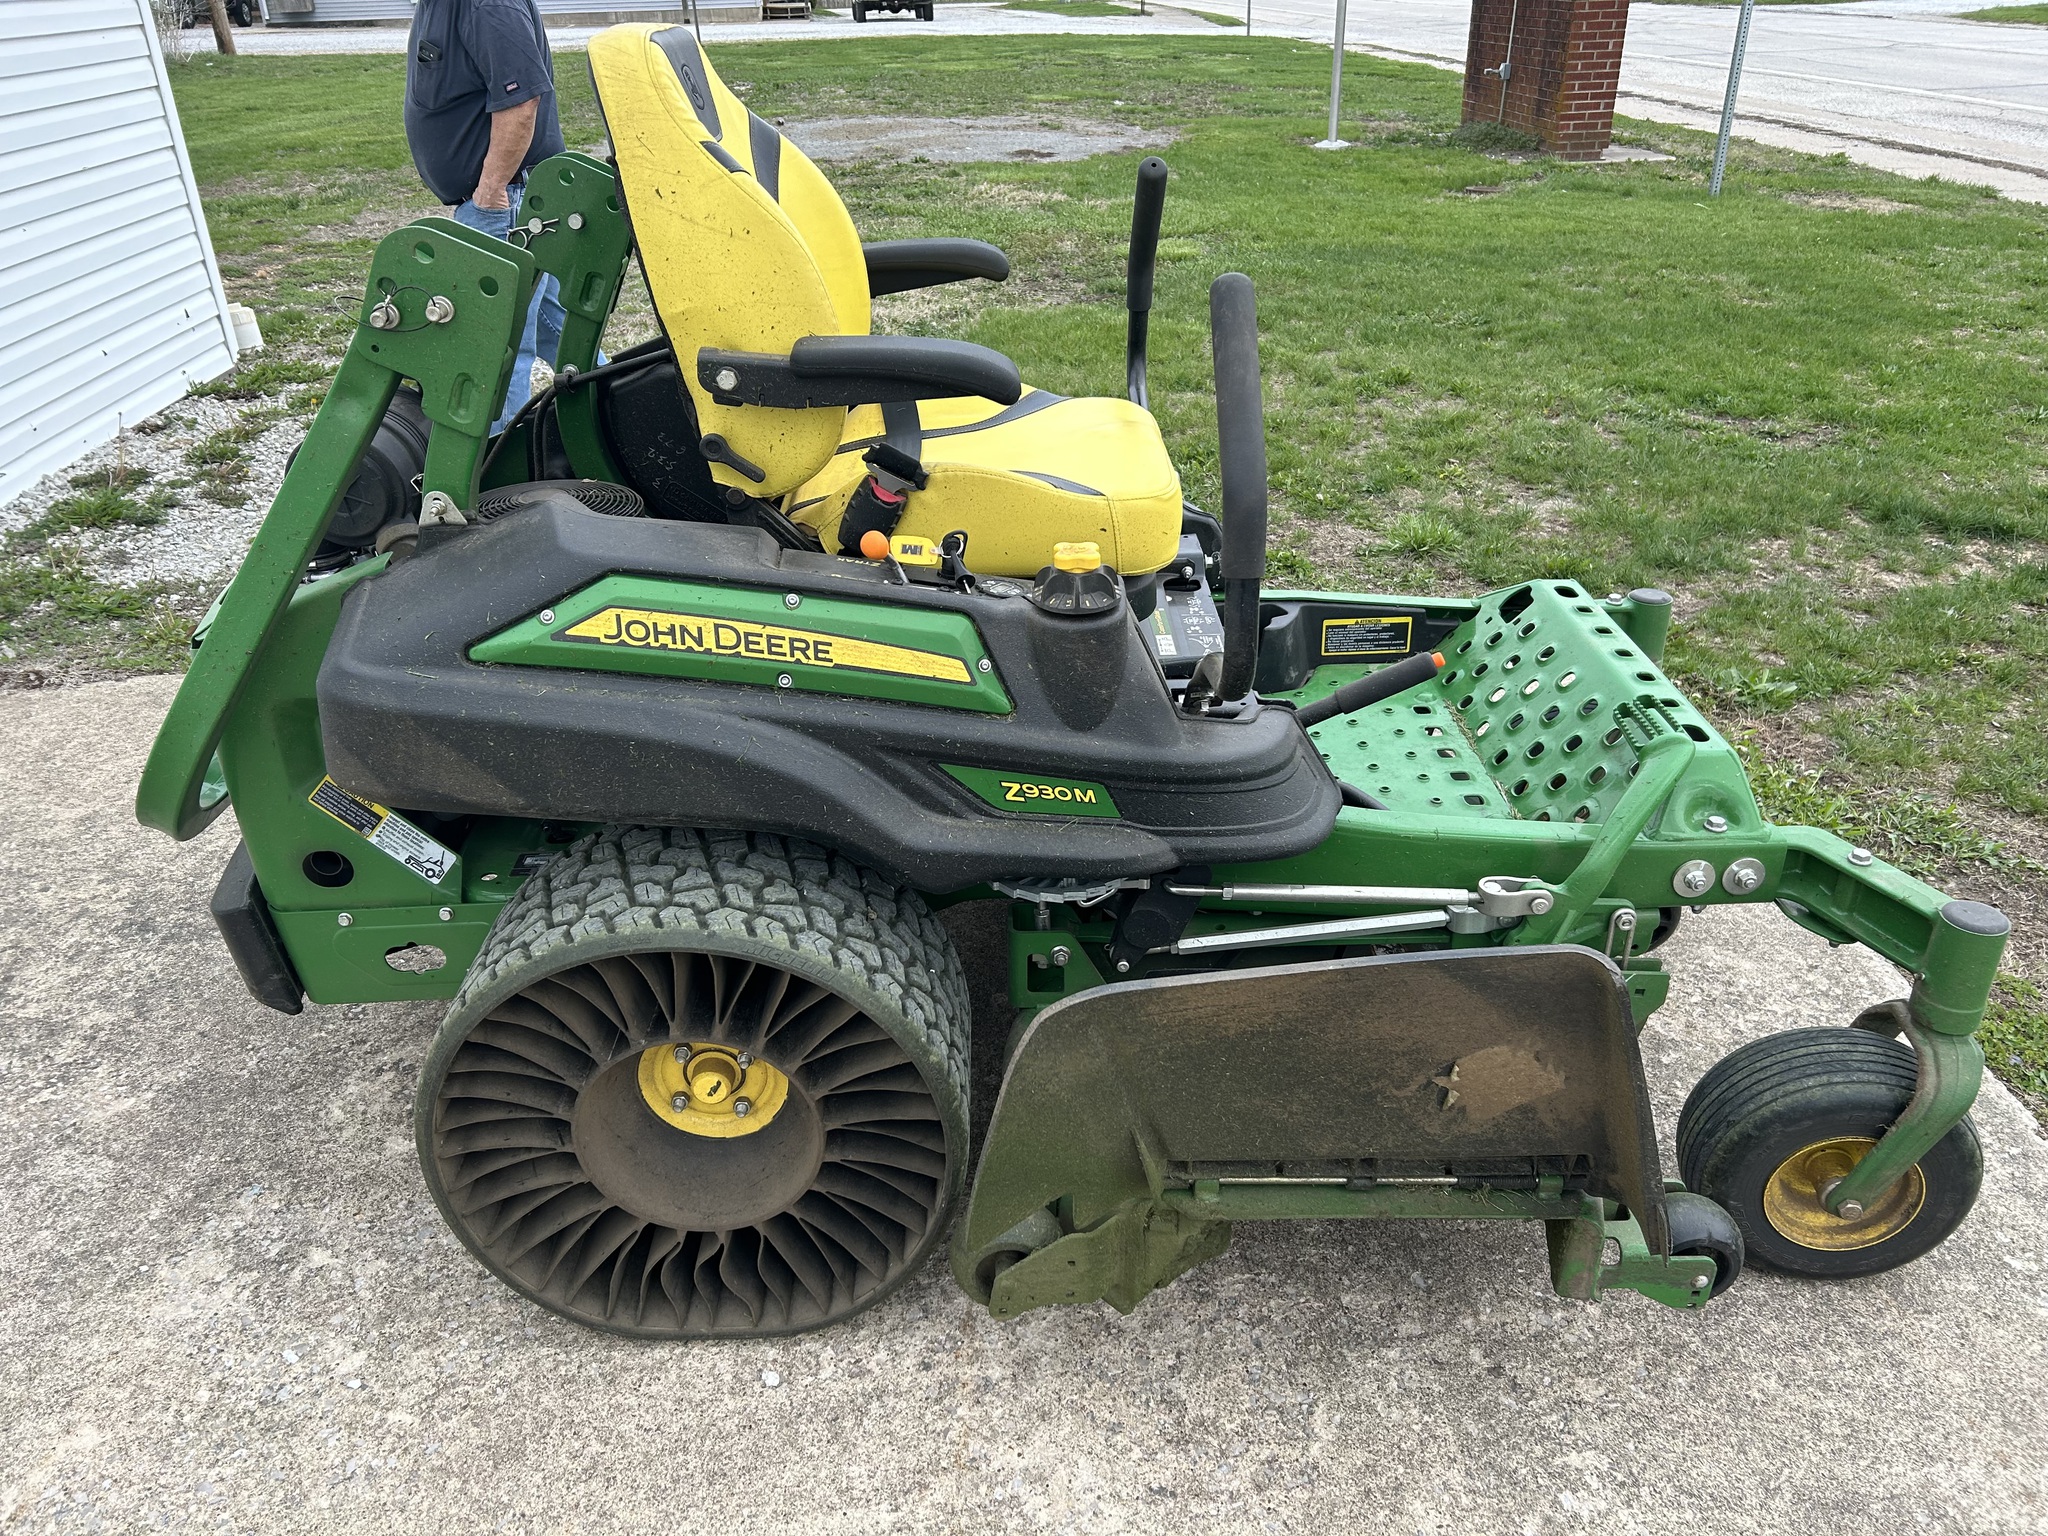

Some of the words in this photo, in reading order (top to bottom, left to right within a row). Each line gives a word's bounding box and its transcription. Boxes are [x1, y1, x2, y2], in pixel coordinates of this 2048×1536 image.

[604, 613, 704, 648] JOHN
[713, 622, 834, 664] DEERE
[1000, 781, 1098, 804] Z930M
[743, 941, 836, 982] MICHELIN
